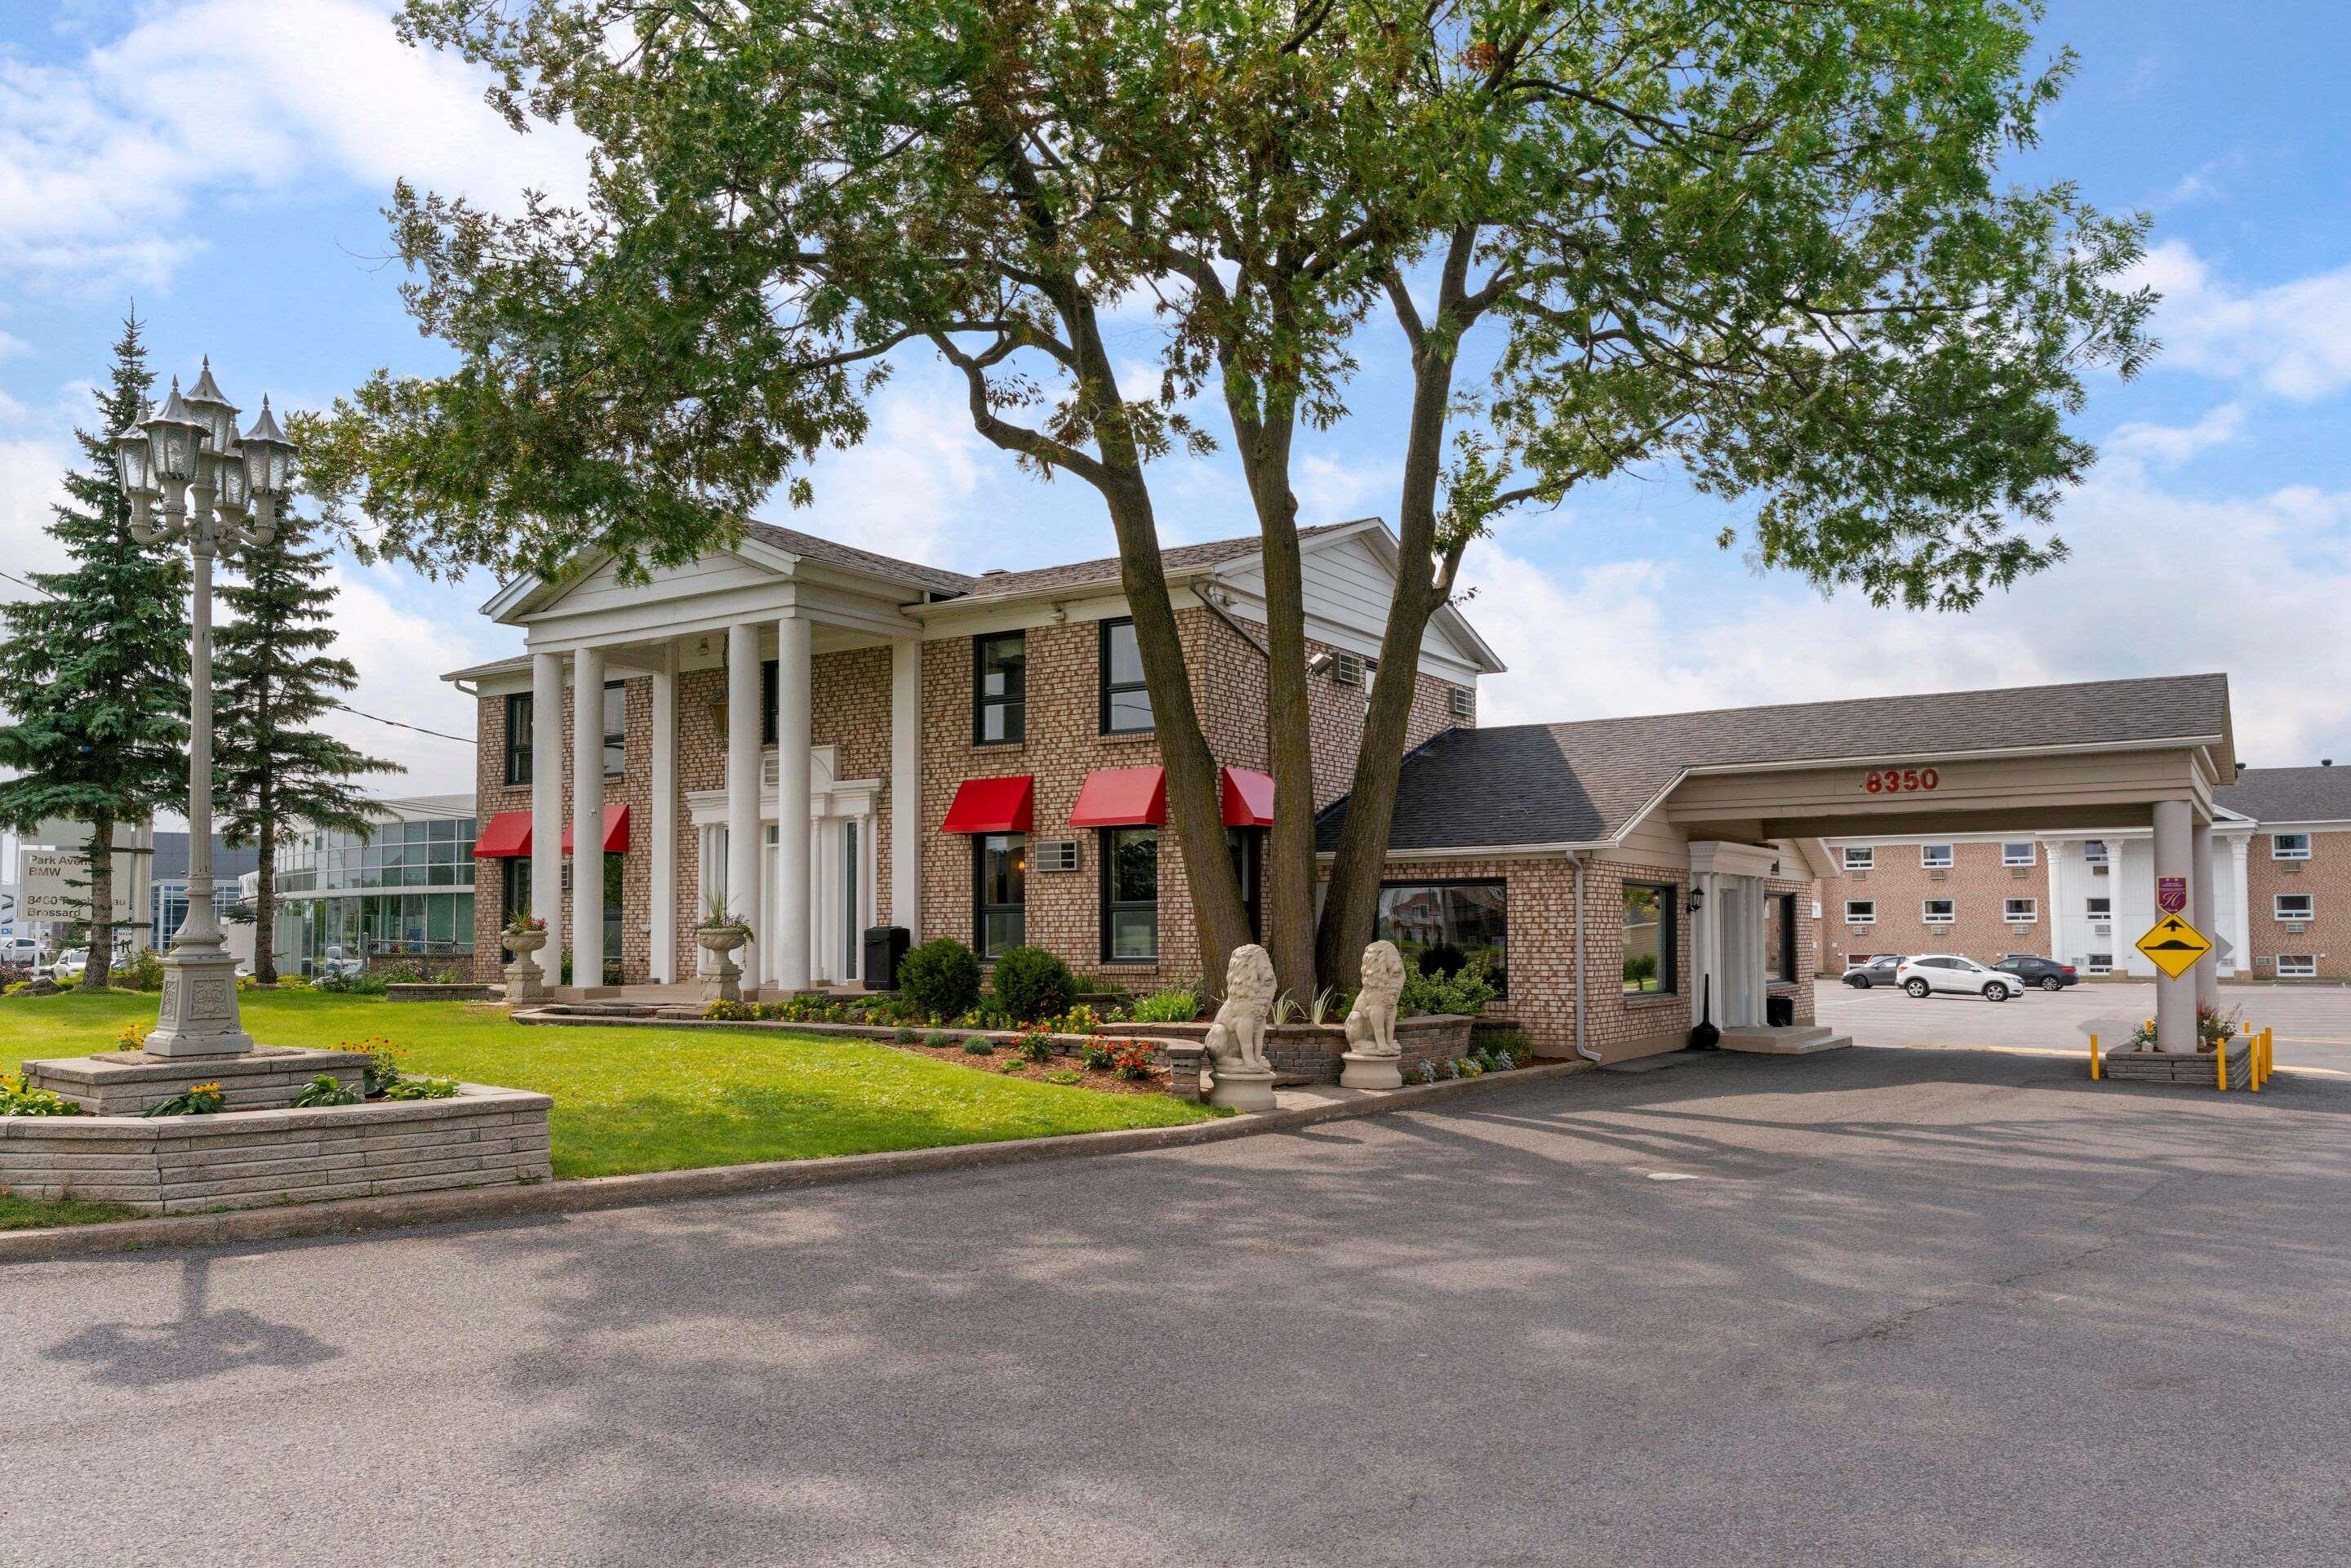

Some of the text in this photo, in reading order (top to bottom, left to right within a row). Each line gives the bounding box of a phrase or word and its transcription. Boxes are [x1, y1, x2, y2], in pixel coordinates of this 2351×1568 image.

[1866, 768, 1940, 793] 8350
[29, 855, 56, 864] Park
[28, 907, 81, 917] Brossard
